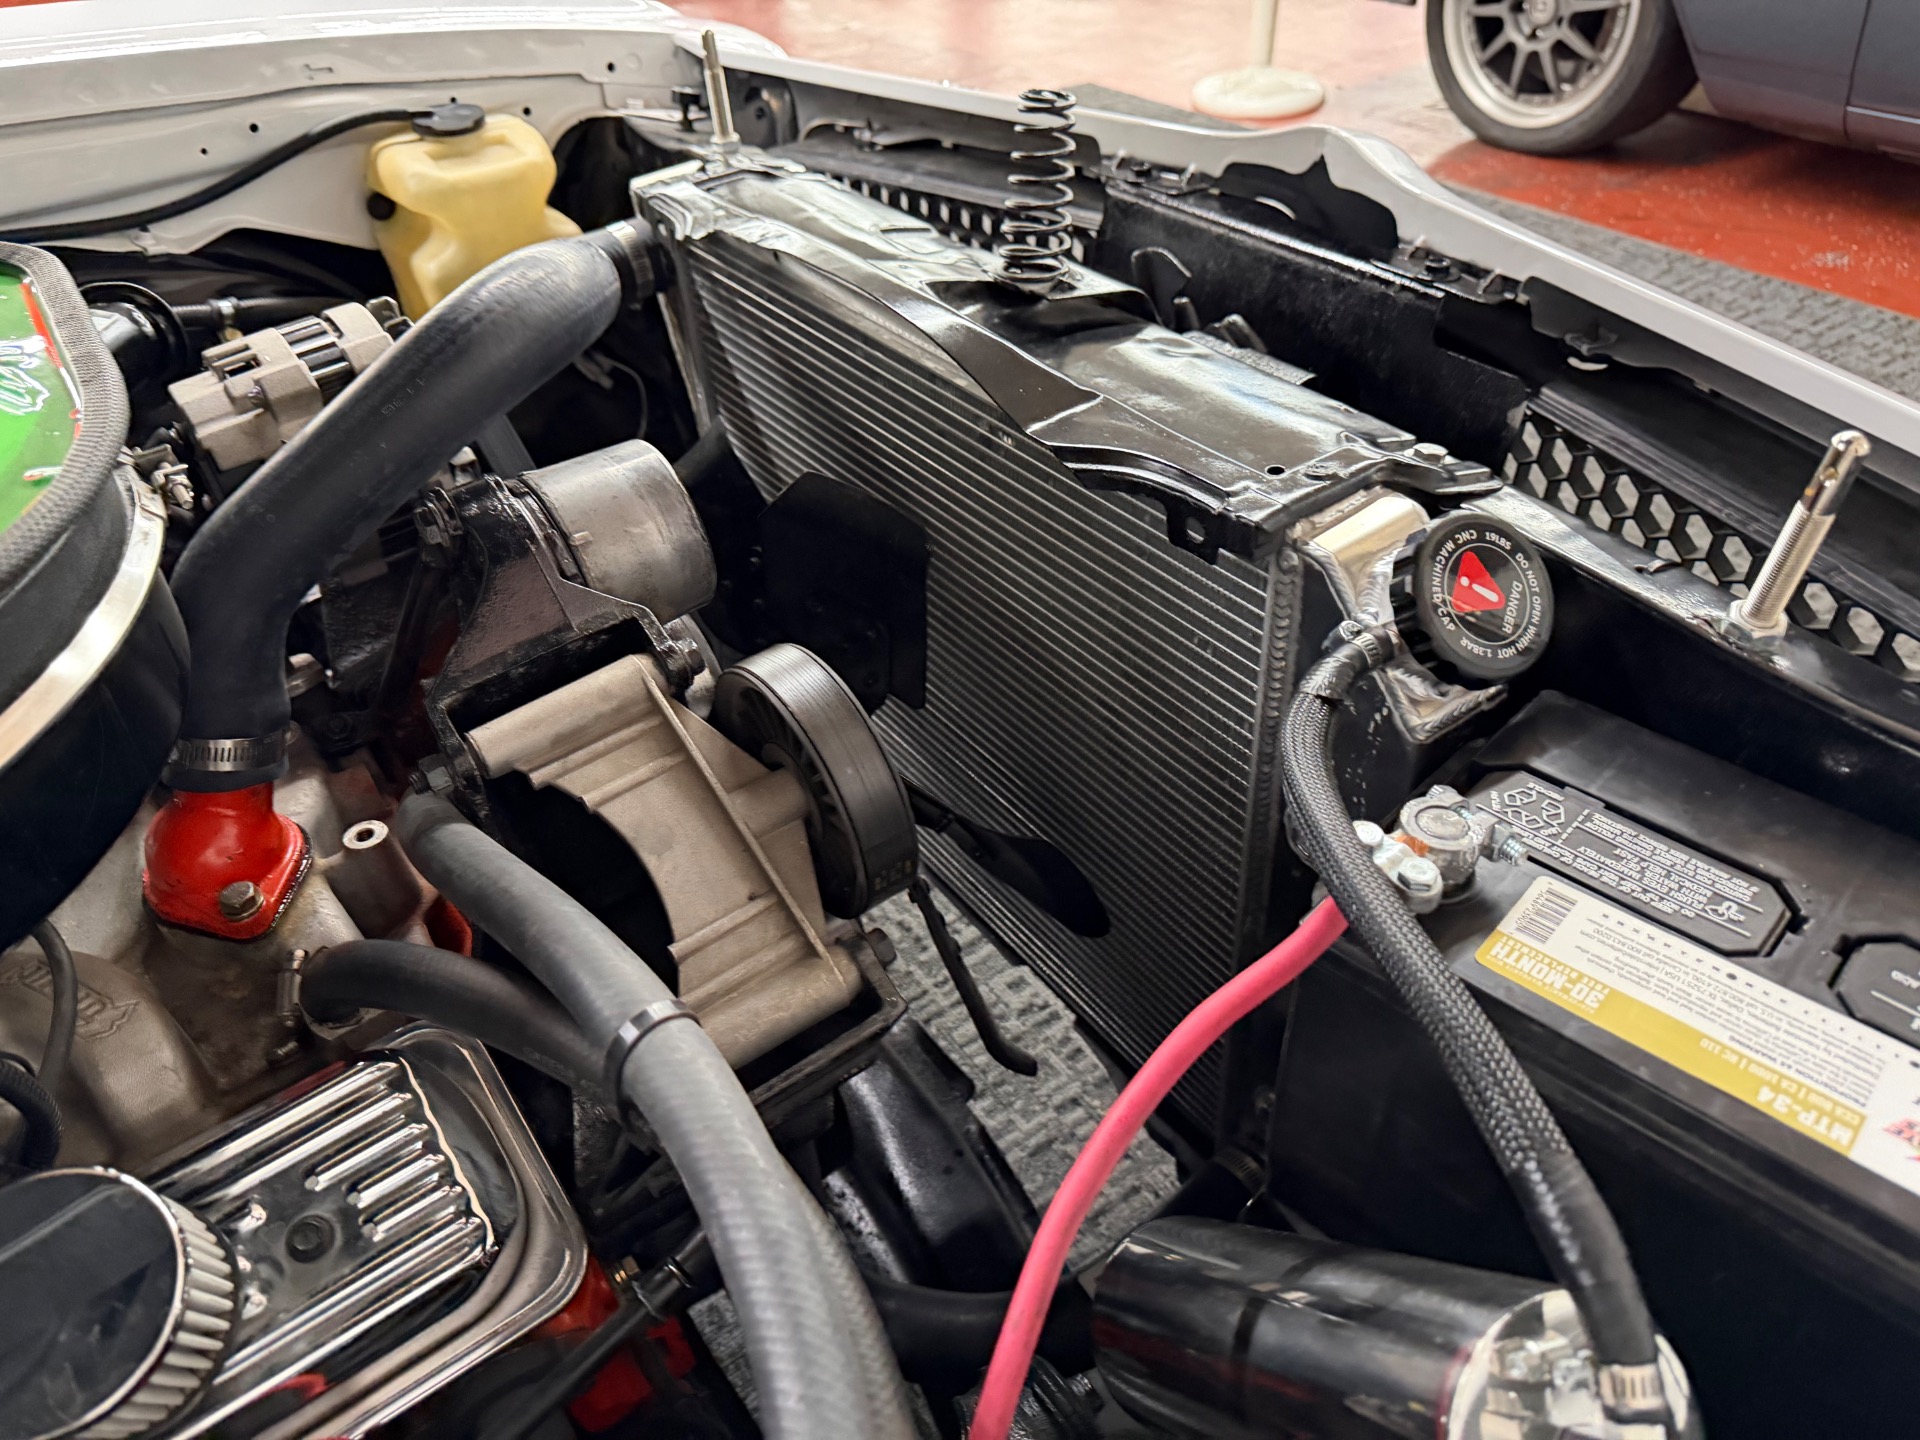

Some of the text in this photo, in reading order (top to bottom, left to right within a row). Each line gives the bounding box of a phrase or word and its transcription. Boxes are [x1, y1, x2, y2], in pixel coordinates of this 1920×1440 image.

[1485, 532, 1512, 550] 19LBS
[1432, 529, 1478, 631] CNC MACHINED CAP
[1497, 552, 1542, 659] DO NOT OPEN WHEN HOT
[1502, 581, 1523, 634] DANGER
[1460, 637, 1492, 658] 1.3BAR
[1559, 855, 1572, 865] OF
[1613, 847, 1712, 897] MEDICAL HELP FAST
[1620, 858, 1641, 871] GET
[1576, 844, 1703, 909] FLUSH EYES IMMEDIATELY
[1617, 884, 1631, 893] OF
[1631, 890, 1650, 902] OUT
[1680, 887, 1707, 903] WITH
[1680, 907, 1695, 917] DO
[1499, 935, 1578, 978] REPLACEMENT
[1488, 940, 1605, 1009] 30-MONTH
[1755, 1083, 1854, 1147] MTP-34
